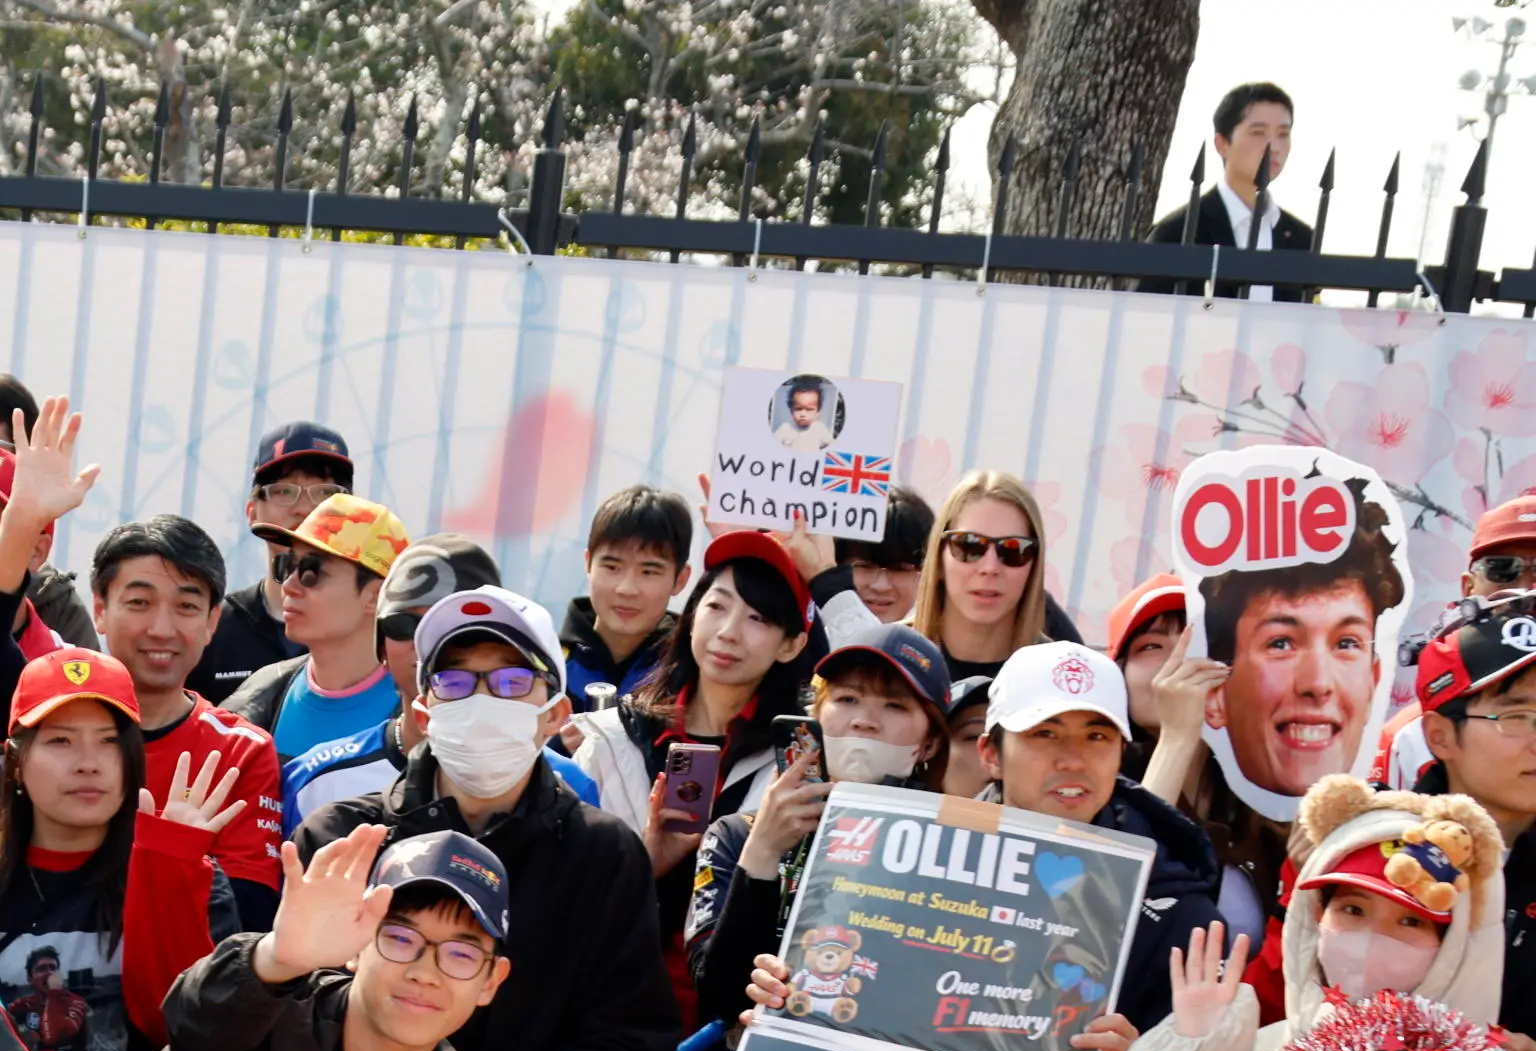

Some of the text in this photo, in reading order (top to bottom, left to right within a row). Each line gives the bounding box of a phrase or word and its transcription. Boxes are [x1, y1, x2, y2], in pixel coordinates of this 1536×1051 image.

[718, 452, 820, 487] World
[1180, 476, 1347, 567] Ollie
[215, 670, 252, 680] MAMMUT
[304, 741, 361, 773] HUGO
[881, 819, 1036, 897] OLLIE
[831, 875, 1080, 940] Honeymoon at Suzuka last year
[847, 910, 993, 956] Wedding on July 11
[935, 970, 1033, 1002] One more
[932, 996, 971, 1026] F1
[967, 1009, 1052, 1040] memory
